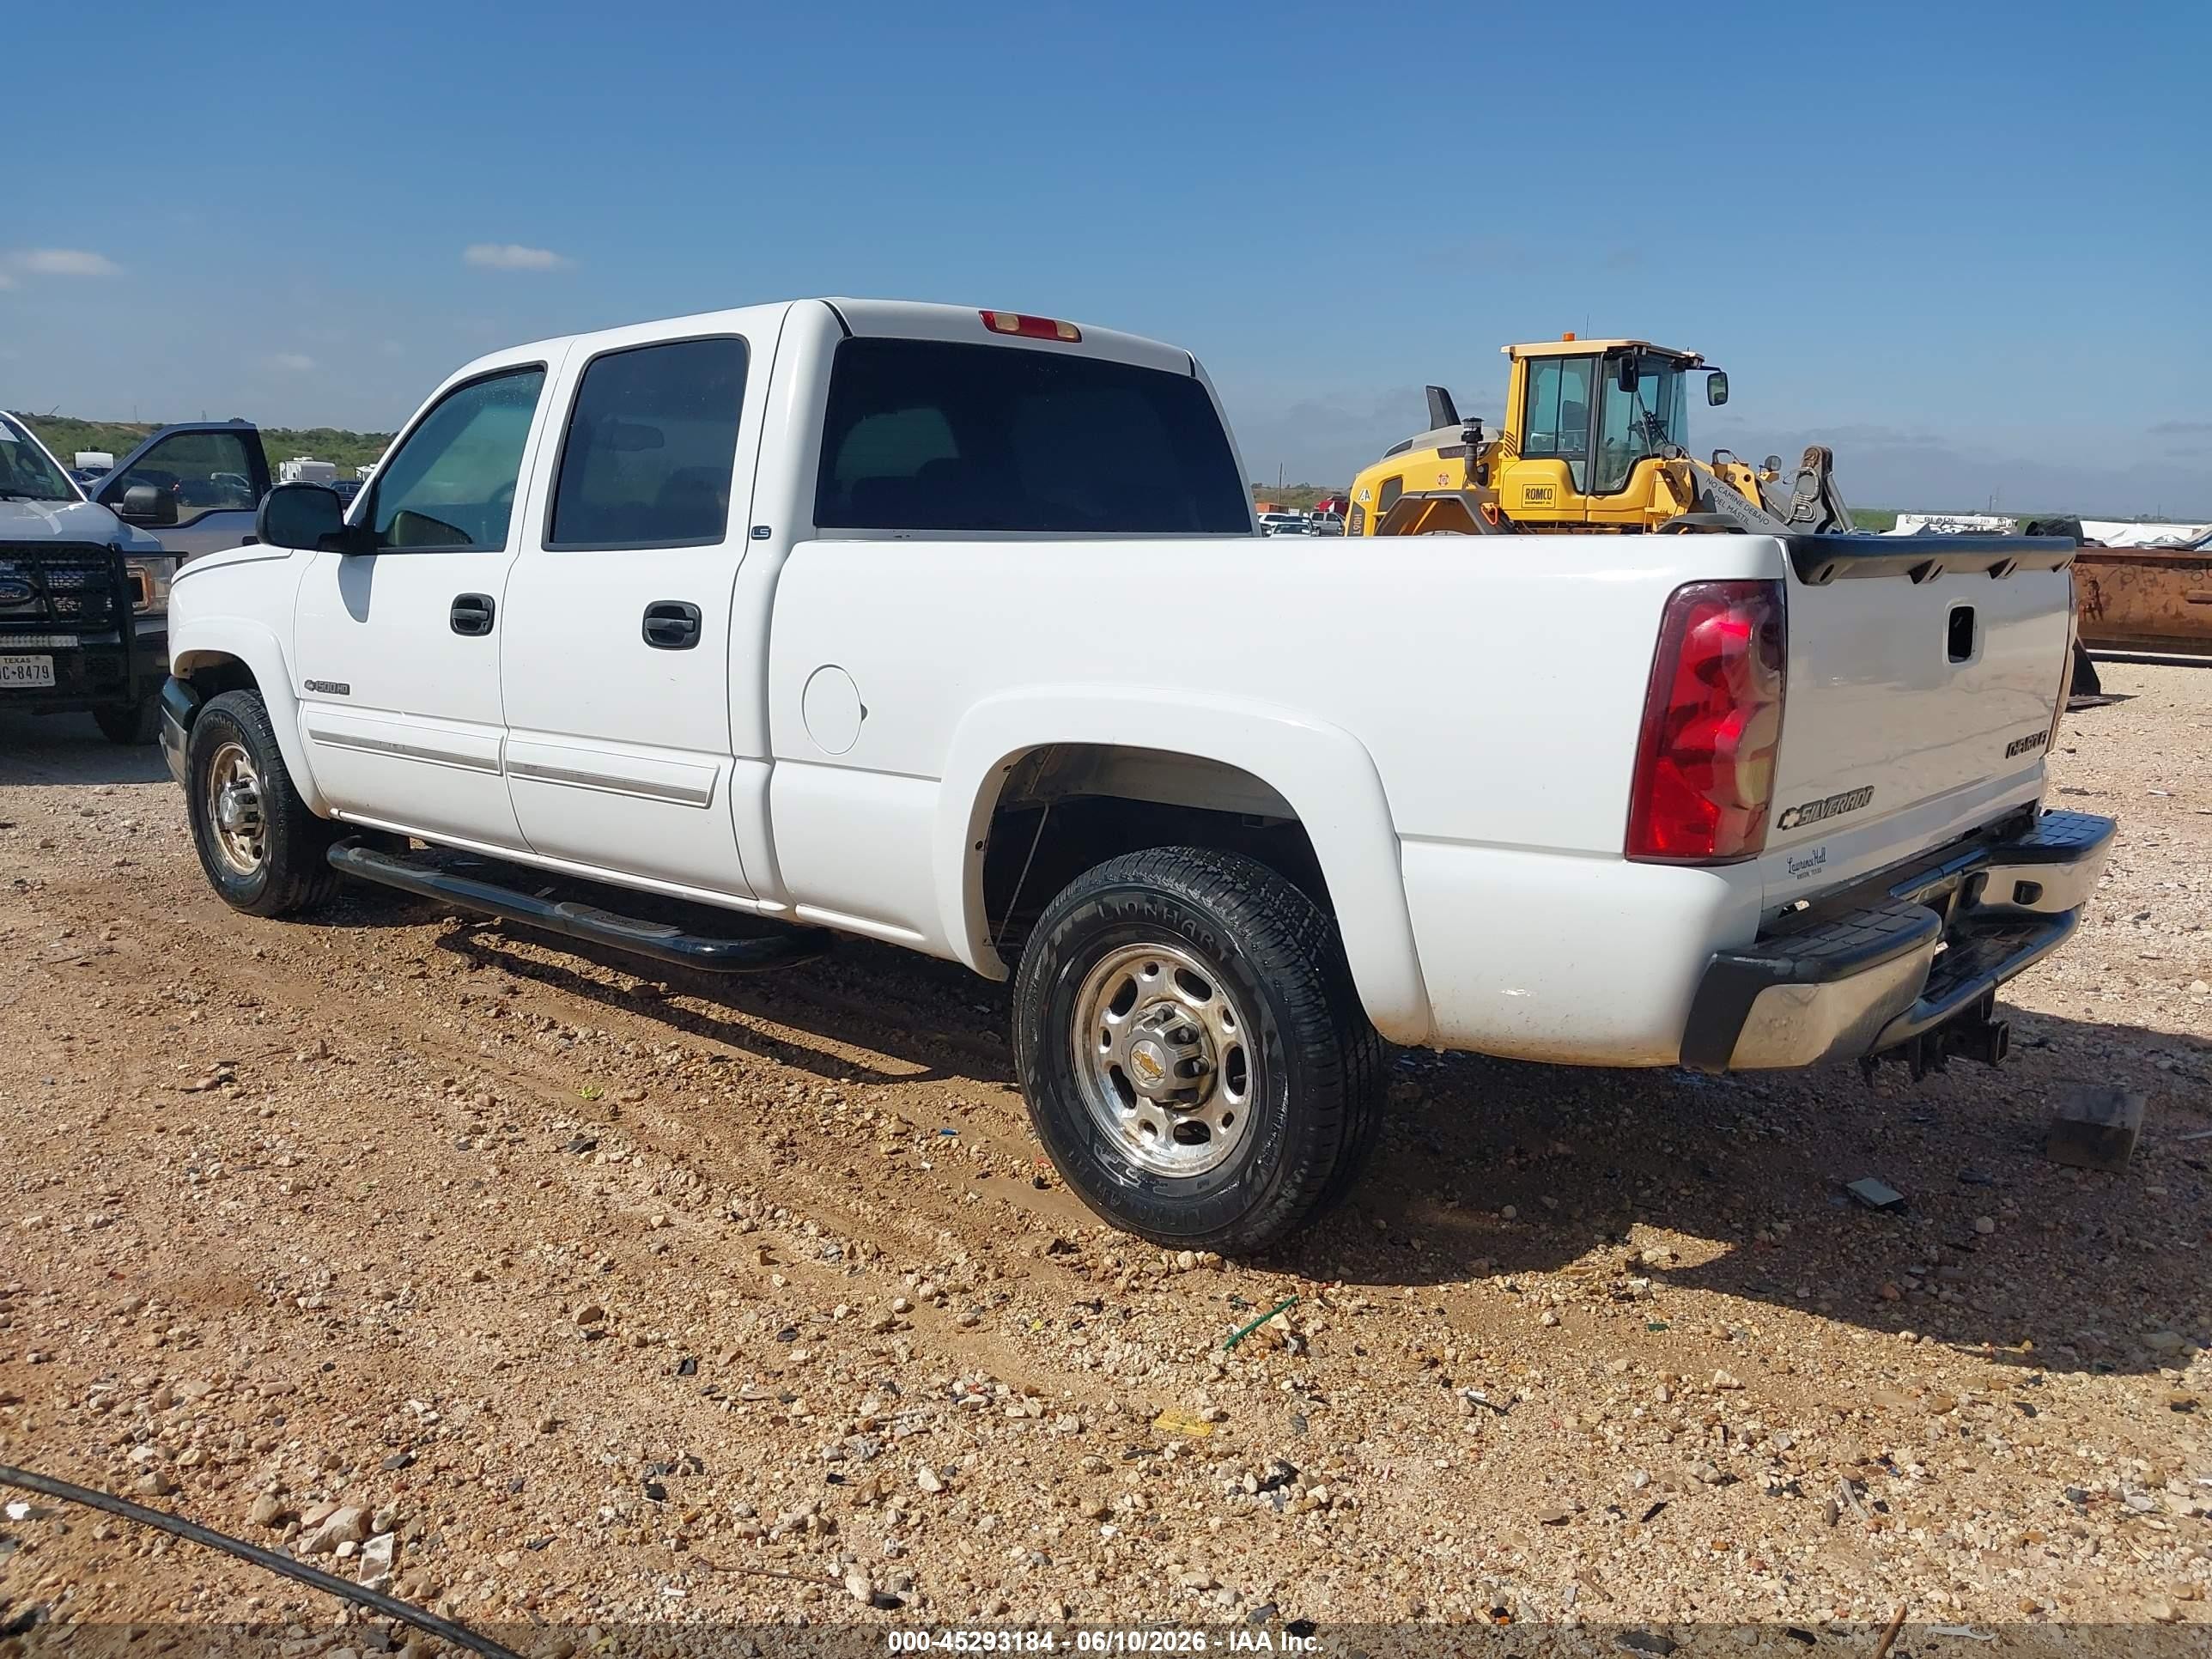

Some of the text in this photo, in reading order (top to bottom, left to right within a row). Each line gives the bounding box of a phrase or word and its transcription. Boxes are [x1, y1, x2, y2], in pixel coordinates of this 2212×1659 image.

[1525, 488, 1553, 501] ROMCO
[1705, 477, 1770, 526] NO CAMINE DEBAJO
[1714, 495, 1726, 507] DEL
[752, 528, 769, 538] LS
[1800, 785, 1875, 825] SILVERADO
[1097, 902, 1237, 962] LIONHART
